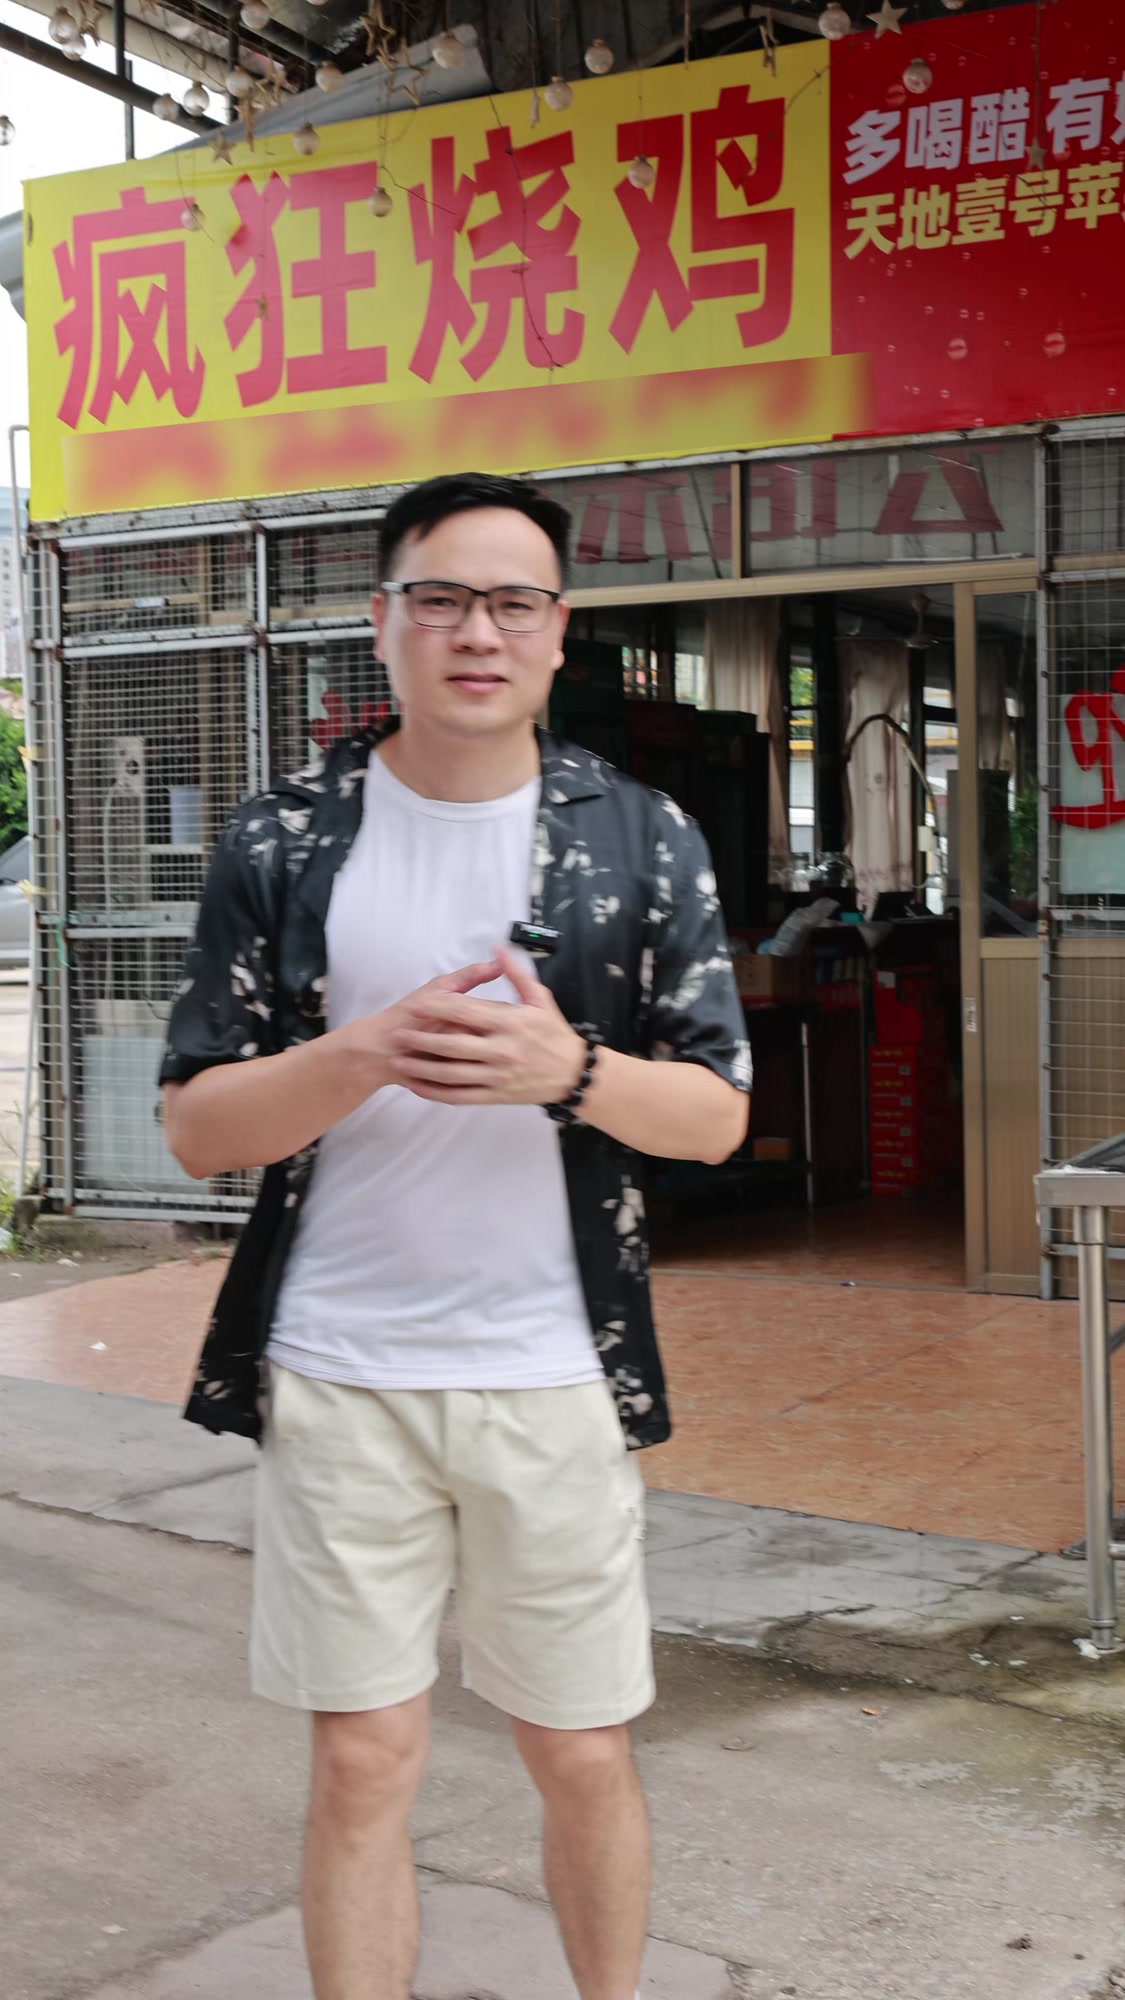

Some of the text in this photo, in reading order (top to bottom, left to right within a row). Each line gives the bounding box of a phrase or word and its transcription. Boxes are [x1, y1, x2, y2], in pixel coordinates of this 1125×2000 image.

[1045, 70, 1125, 156] 有
[53, 84, 796, 431] 疯狂烧鸡
[843, 161, 1125, 259] 天地壹号苹
